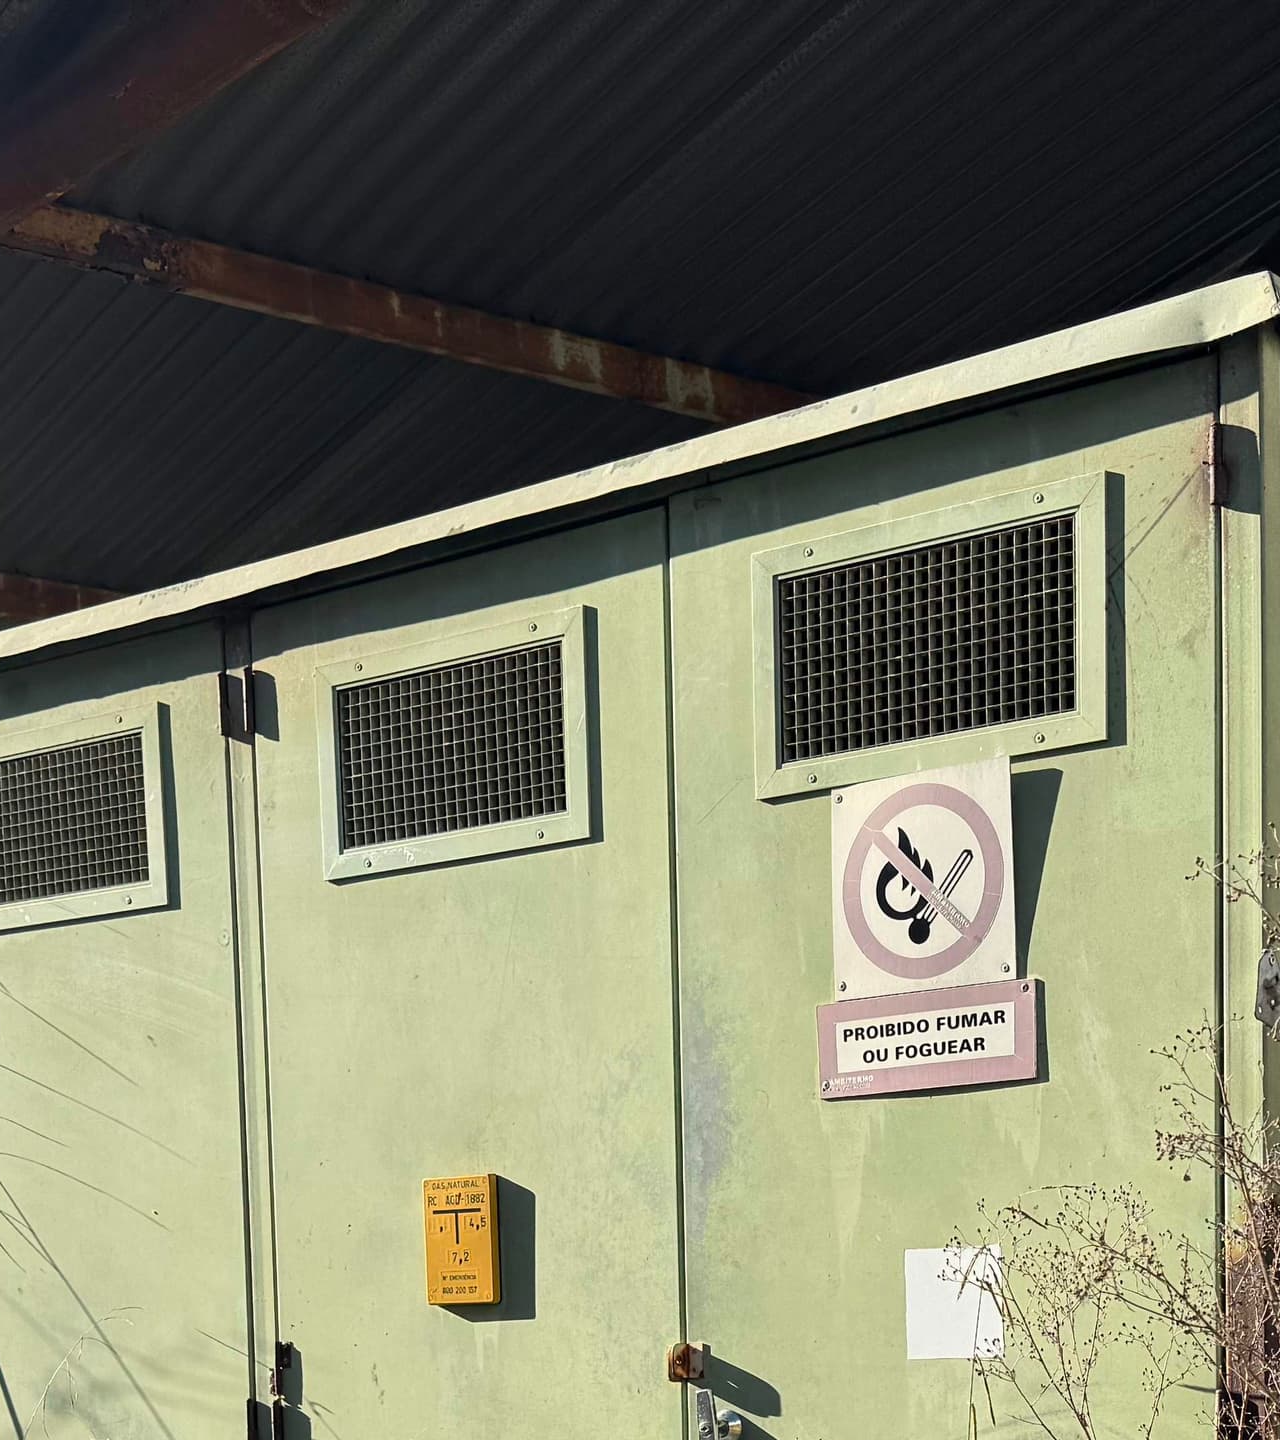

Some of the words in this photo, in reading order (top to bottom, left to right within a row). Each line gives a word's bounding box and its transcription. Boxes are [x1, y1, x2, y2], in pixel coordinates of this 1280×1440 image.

[843, 1019, 930, 1043] PROIBIDO
[936, 1010, 1006, 1032] FUMAR
[862, 1048, 888, 1063] OU
[895, 1037, 986, 1060] FOGUEAR
[452, 1251, 470, 1265] 7,2
